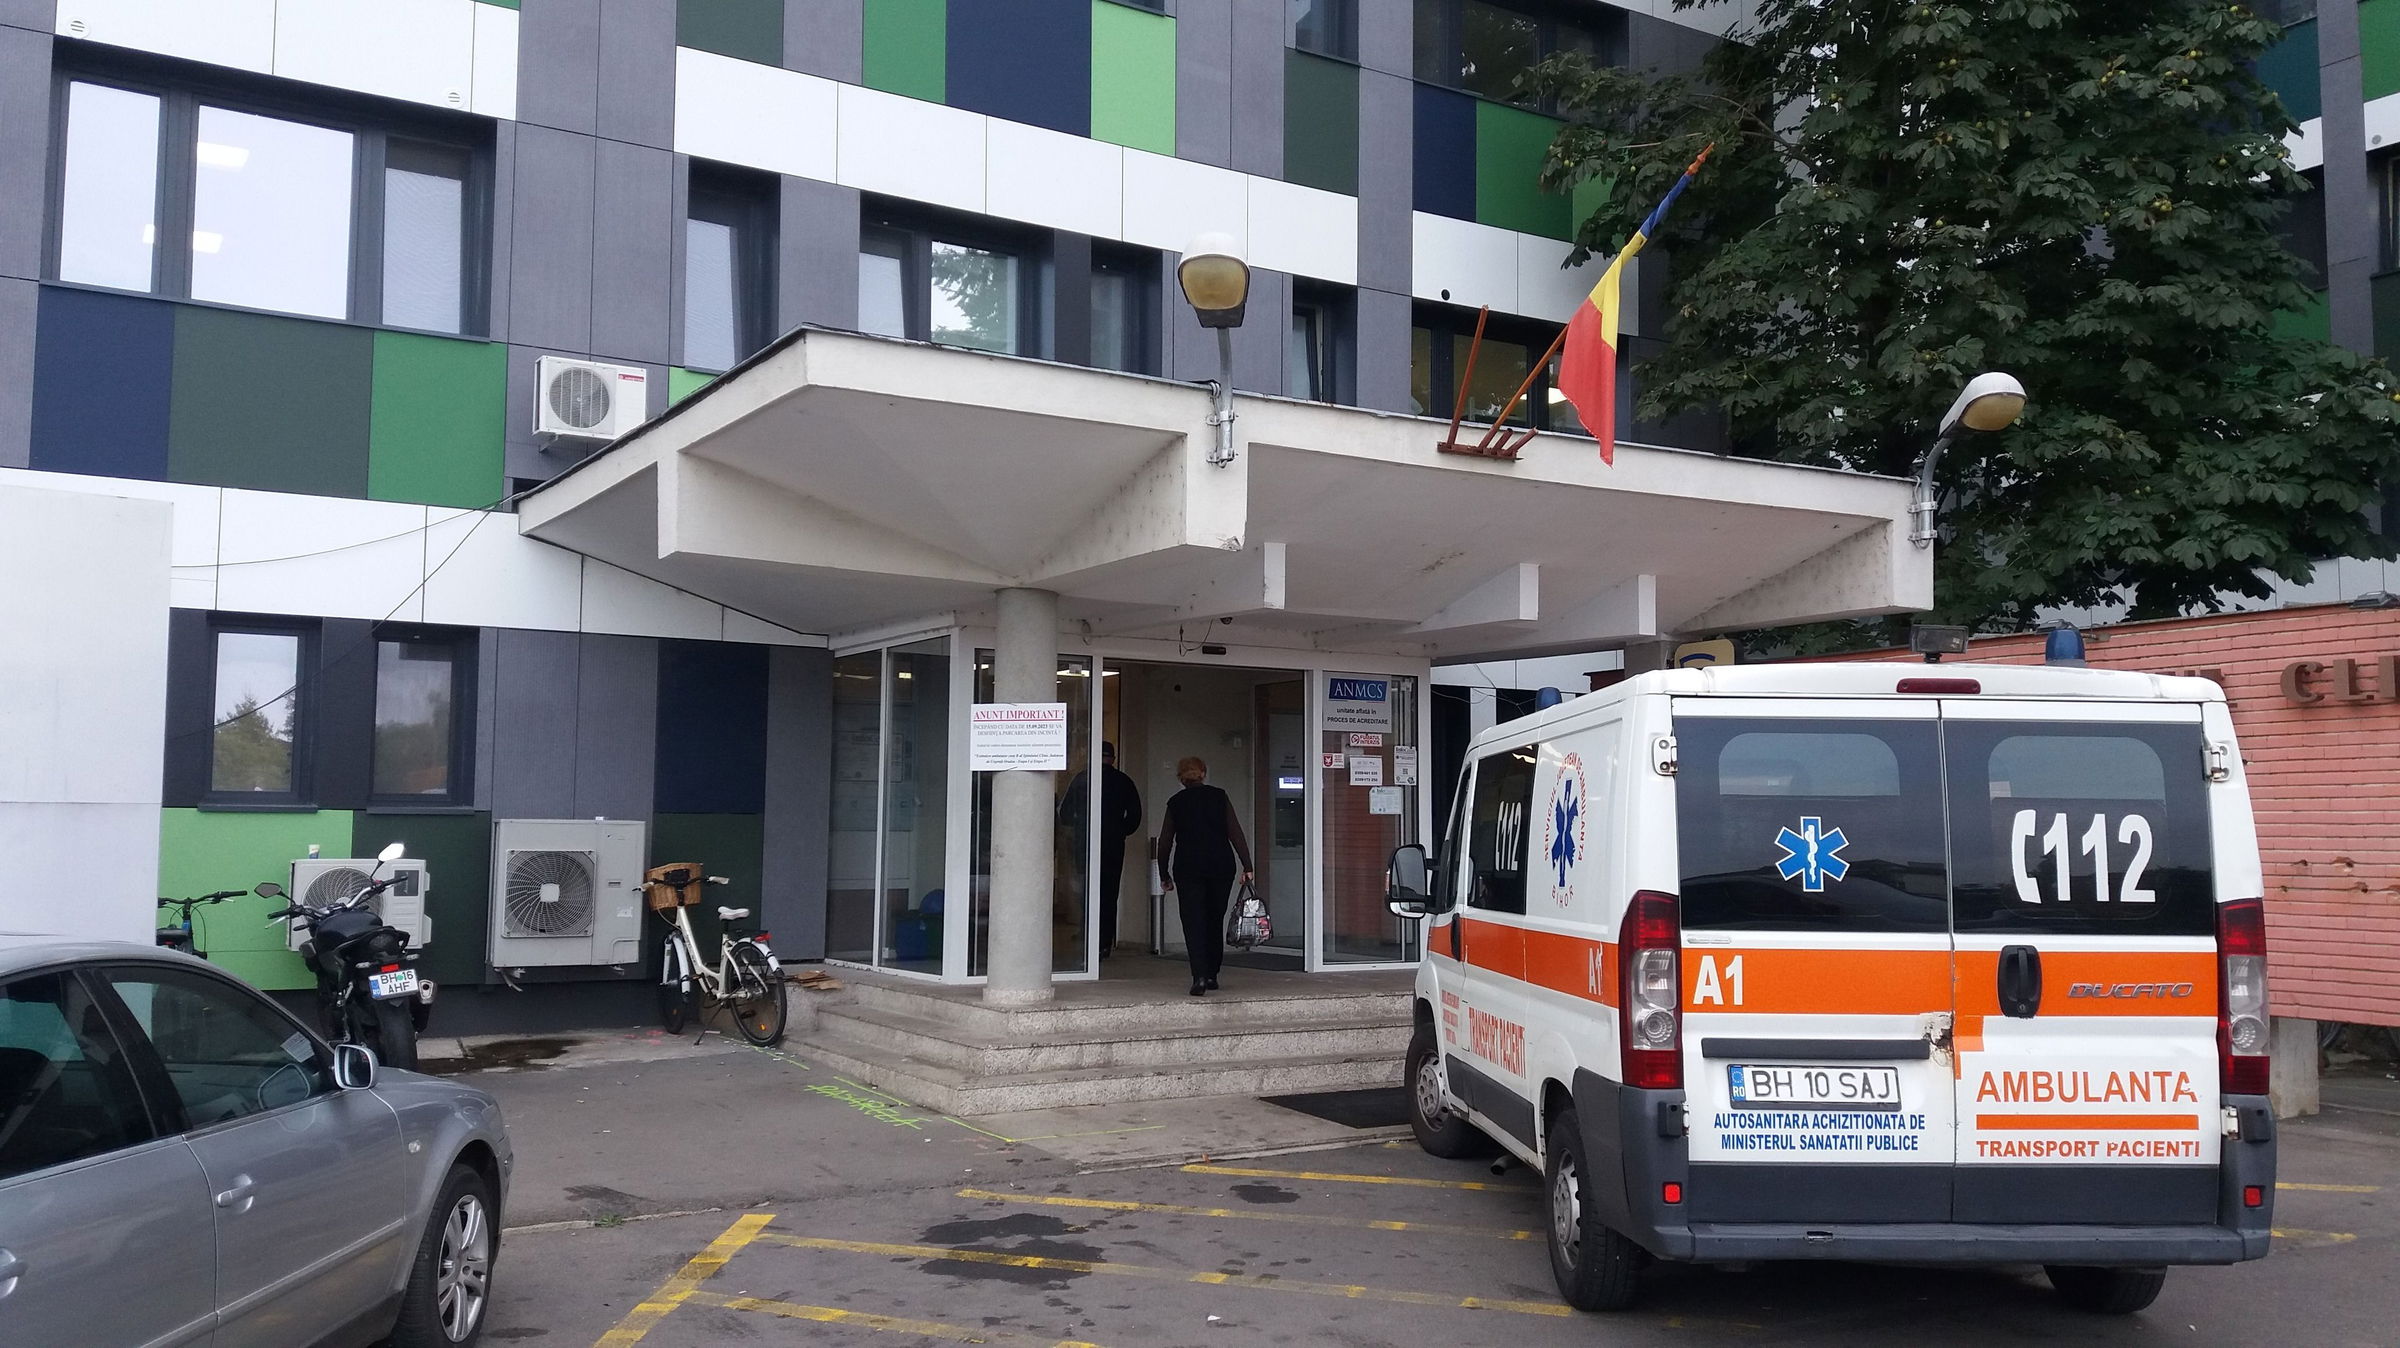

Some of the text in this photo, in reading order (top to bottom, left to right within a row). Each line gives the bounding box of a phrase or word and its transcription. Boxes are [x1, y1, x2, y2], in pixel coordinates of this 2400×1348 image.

[1334, 682, 1383, 699] ANMCS
[1007, 710, 1060, 719] IMPORTANT
[1501, 802, 1522, 871] 112
[2043, 812, 2156, 903] 112
[381, 971, 413, 984] BH 16
[1588, 947, 1602, 996] A1
[1693, 955, 1743, 1006] A1
[2067, 982, 2194, 999] DUCATO
[1732, 1086, 1746, 1098] RO
[1751, 1070, 1891, 1099] BH 10 SAJ
[1976, 1071, 2199, 1103] AMBULANTA
[1714, 1113, 1926, 1130] AUTOSANITARA ACHIZITIONATA DE
[1721, 1134, 1919, 1151] MINISTERUL SANATATII PUBLICE
[1976, 1140, 2200, 1157] TRANSPORT PACIENTI
